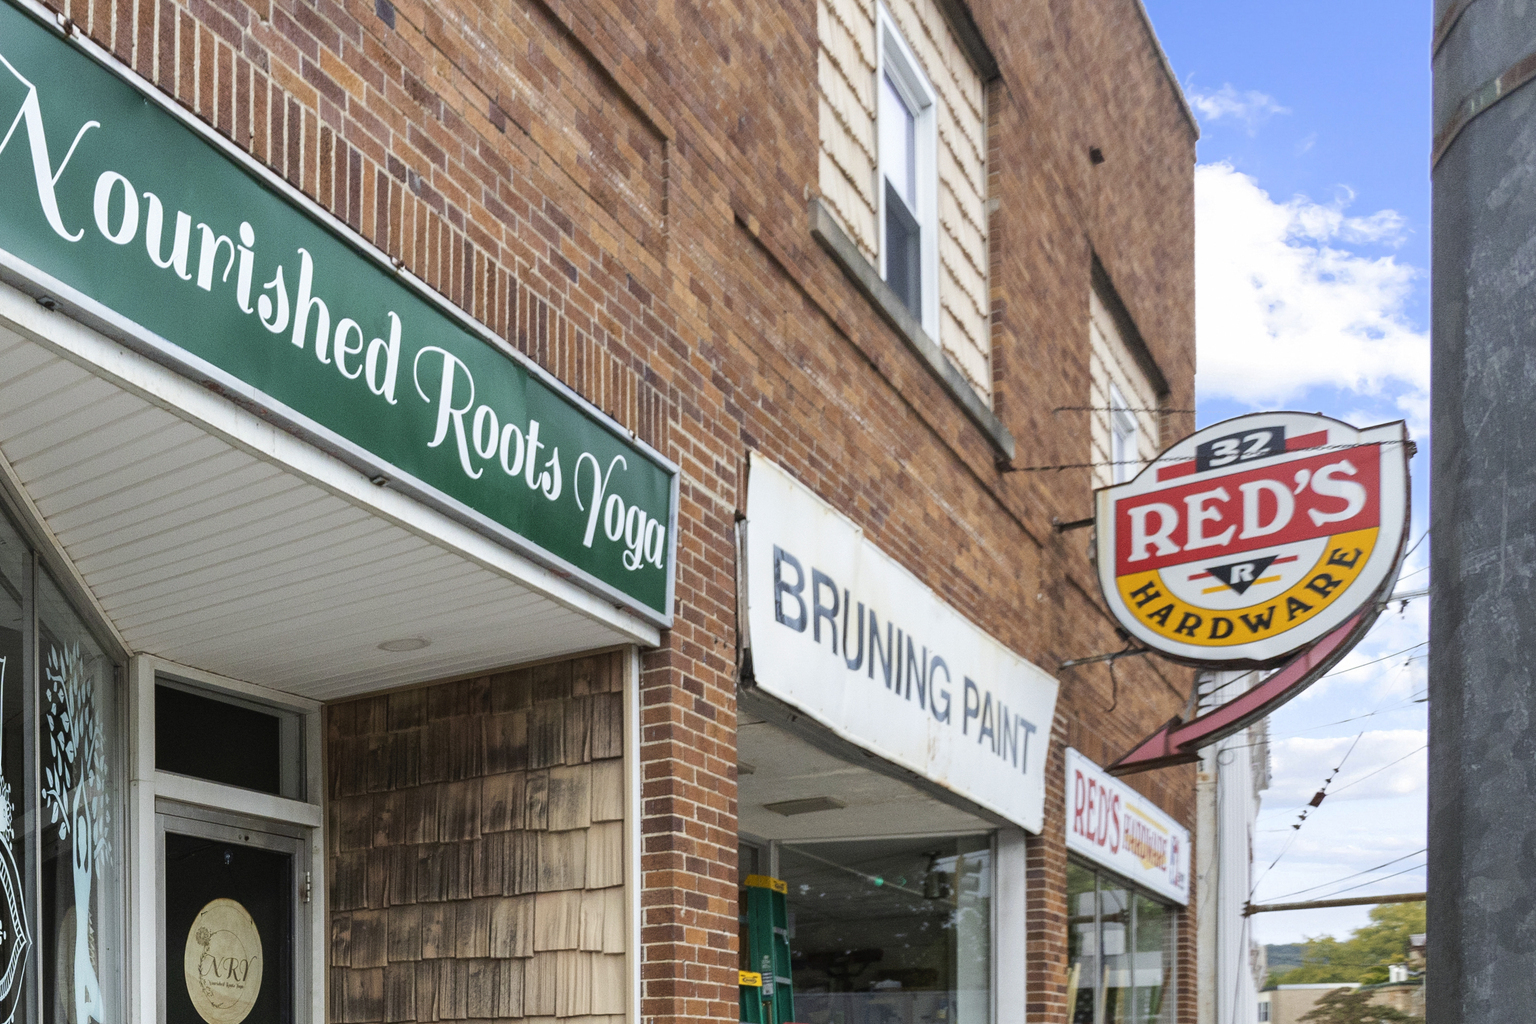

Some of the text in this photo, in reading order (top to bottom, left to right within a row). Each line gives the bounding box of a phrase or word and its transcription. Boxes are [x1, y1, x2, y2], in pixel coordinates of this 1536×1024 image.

[413, 345, 562, 501] Roots
[574, 451, 665, 571] Yoga
[1209, 431, 1274, 468] 32
[1126, 459, 1367, 563] RED'S
[1130, 547, 1363, 640] HARDWARE
[1229, 563, 1255, 585] R
[773, 543, 1037, 775] BRUNING PAINT
[1073, 769, 1121, 855] RED'S
